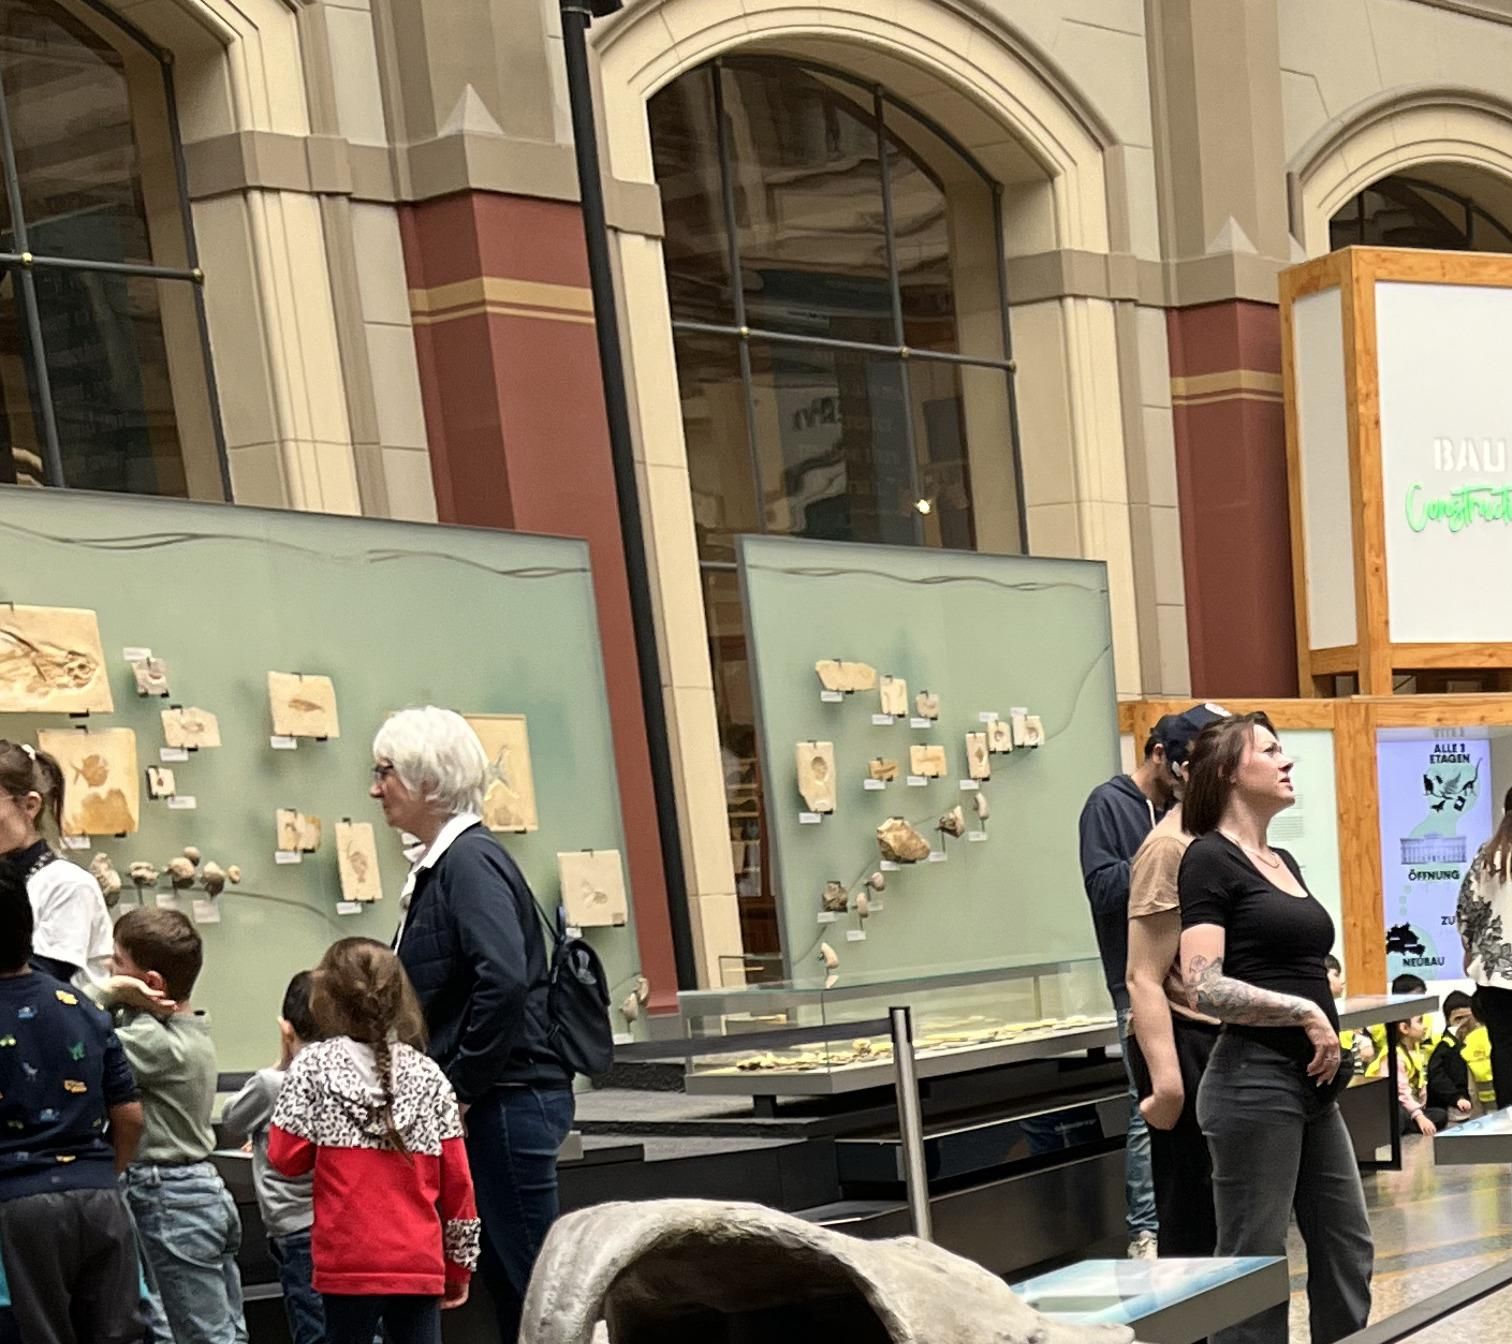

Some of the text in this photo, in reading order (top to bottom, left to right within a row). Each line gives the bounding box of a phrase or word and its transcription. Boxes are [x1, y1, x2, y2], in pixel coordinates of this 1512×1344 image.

[1433, 436, 1507, 473] BAU
[1434, 743, 1457, 753] ALLE
[1429, 754, 1470, 764] ETAGEN
[1408, 869, 1460, 881] ÖFFNUNG
[1402, 957, 1445, 967] NEUBAU
